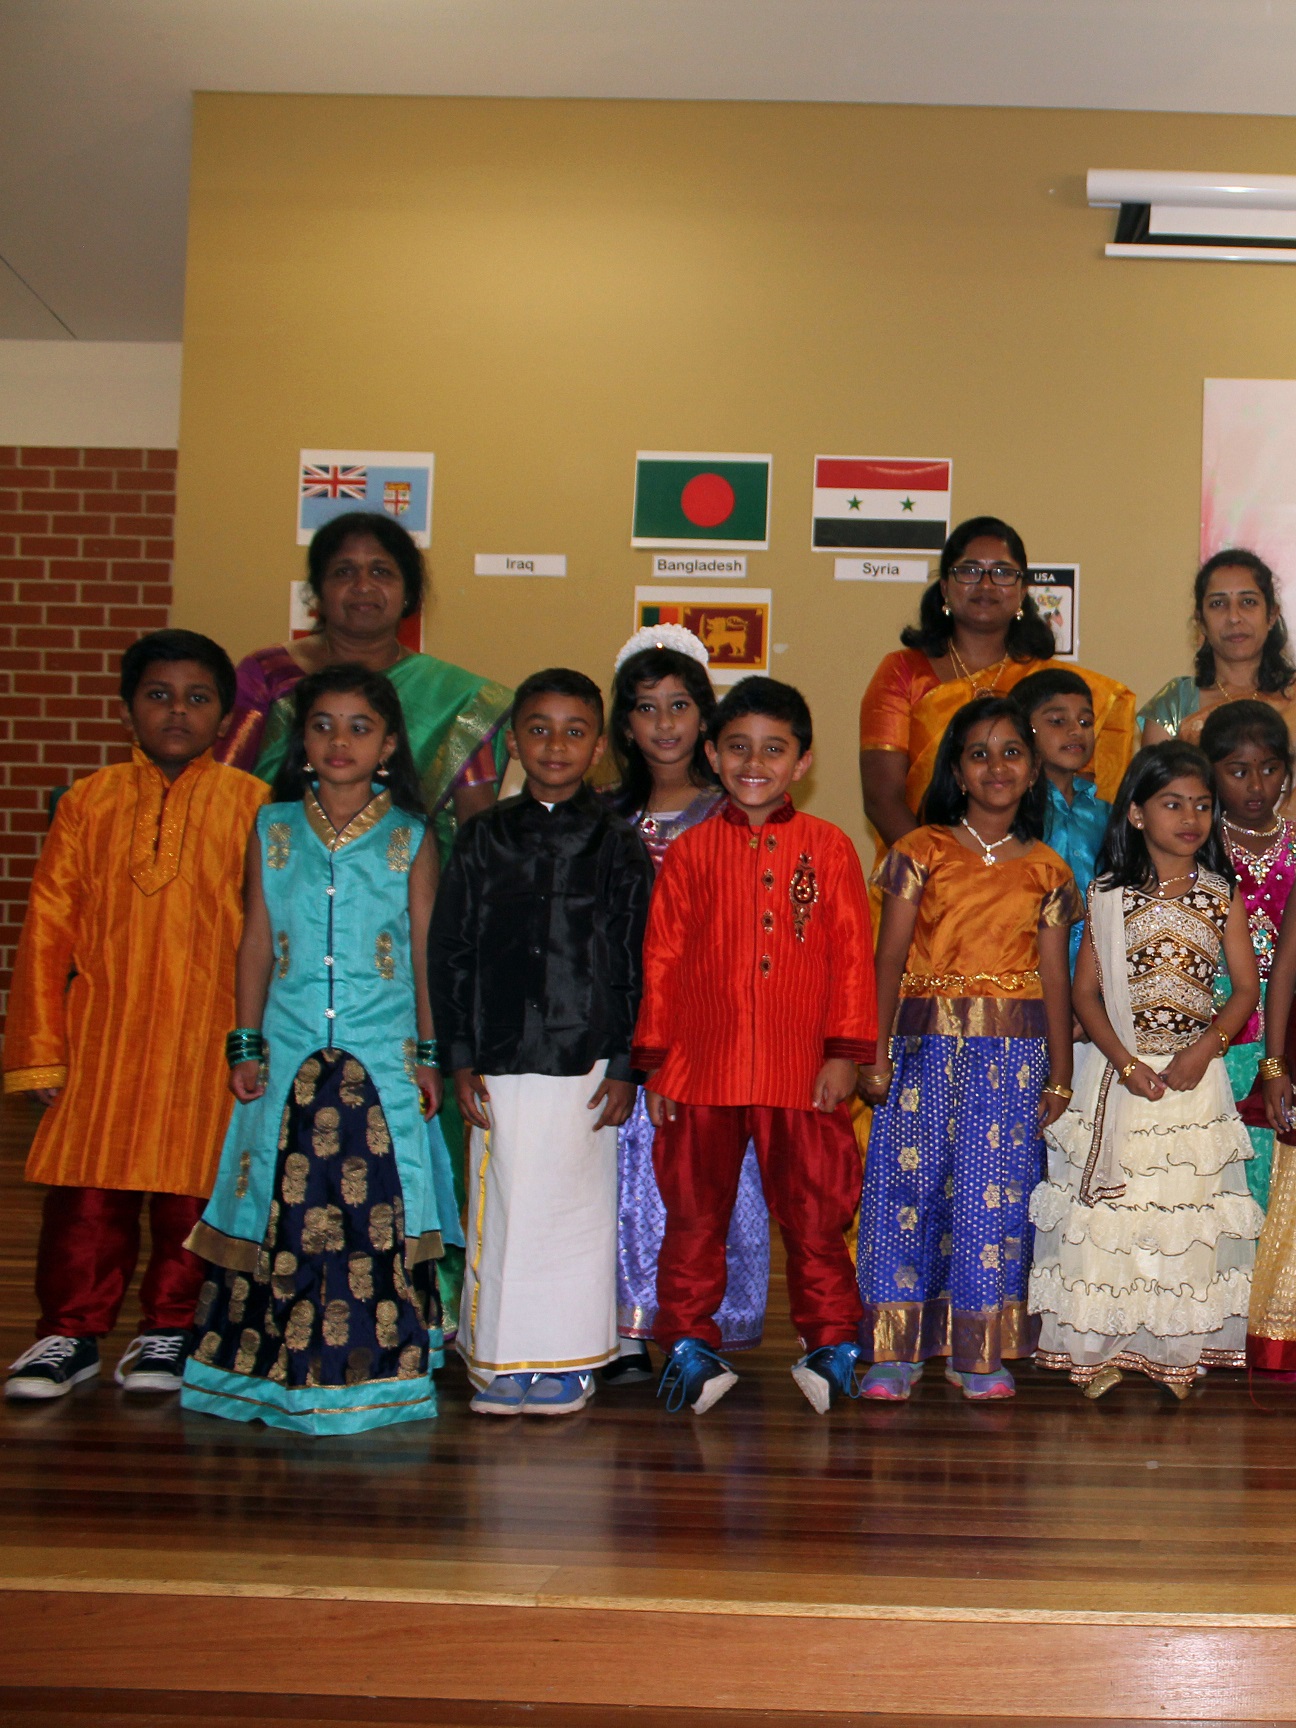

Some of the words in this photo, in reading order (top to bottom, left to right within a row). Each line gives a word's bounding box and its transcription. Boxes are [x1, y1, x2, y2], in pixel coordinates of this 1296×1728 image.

[506, 557, 534, 572] Iraq
[657, 558, 742, 573] Bangladesh
[862, 561, 900, 577] Syria
[1034, 572, 1057, 582] USA
